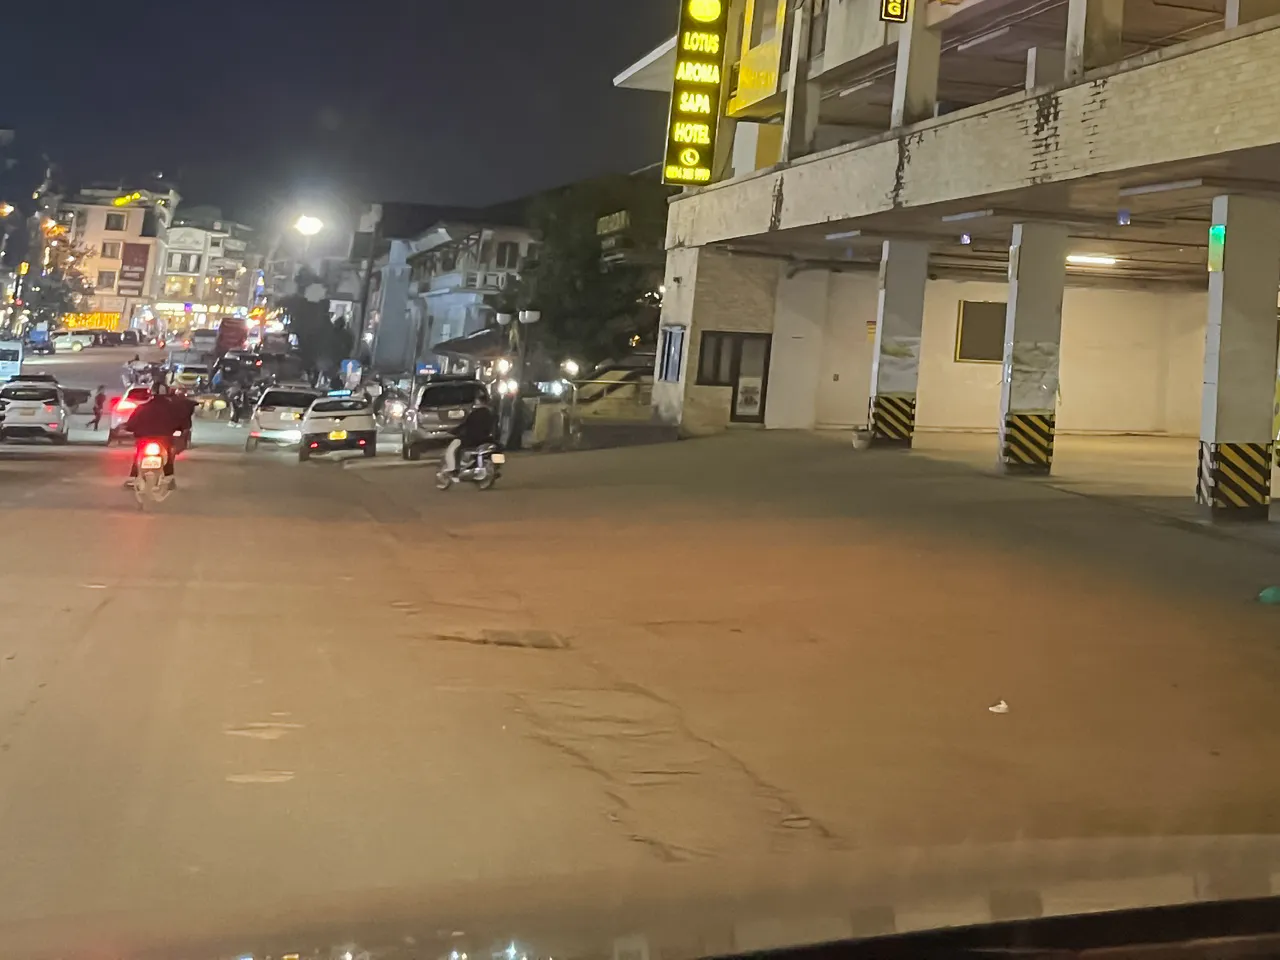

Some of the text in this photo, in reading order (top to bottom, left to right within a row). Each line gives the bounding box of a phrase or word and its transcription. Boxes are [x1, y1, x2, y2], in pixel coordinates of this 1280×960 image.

[683, 31, 719, 54] LOTUS
[675, 62, 720, 84] AROMA
[679, 91, 711, 114] SAPA
[673, 122, 711, 145] HOTEL
